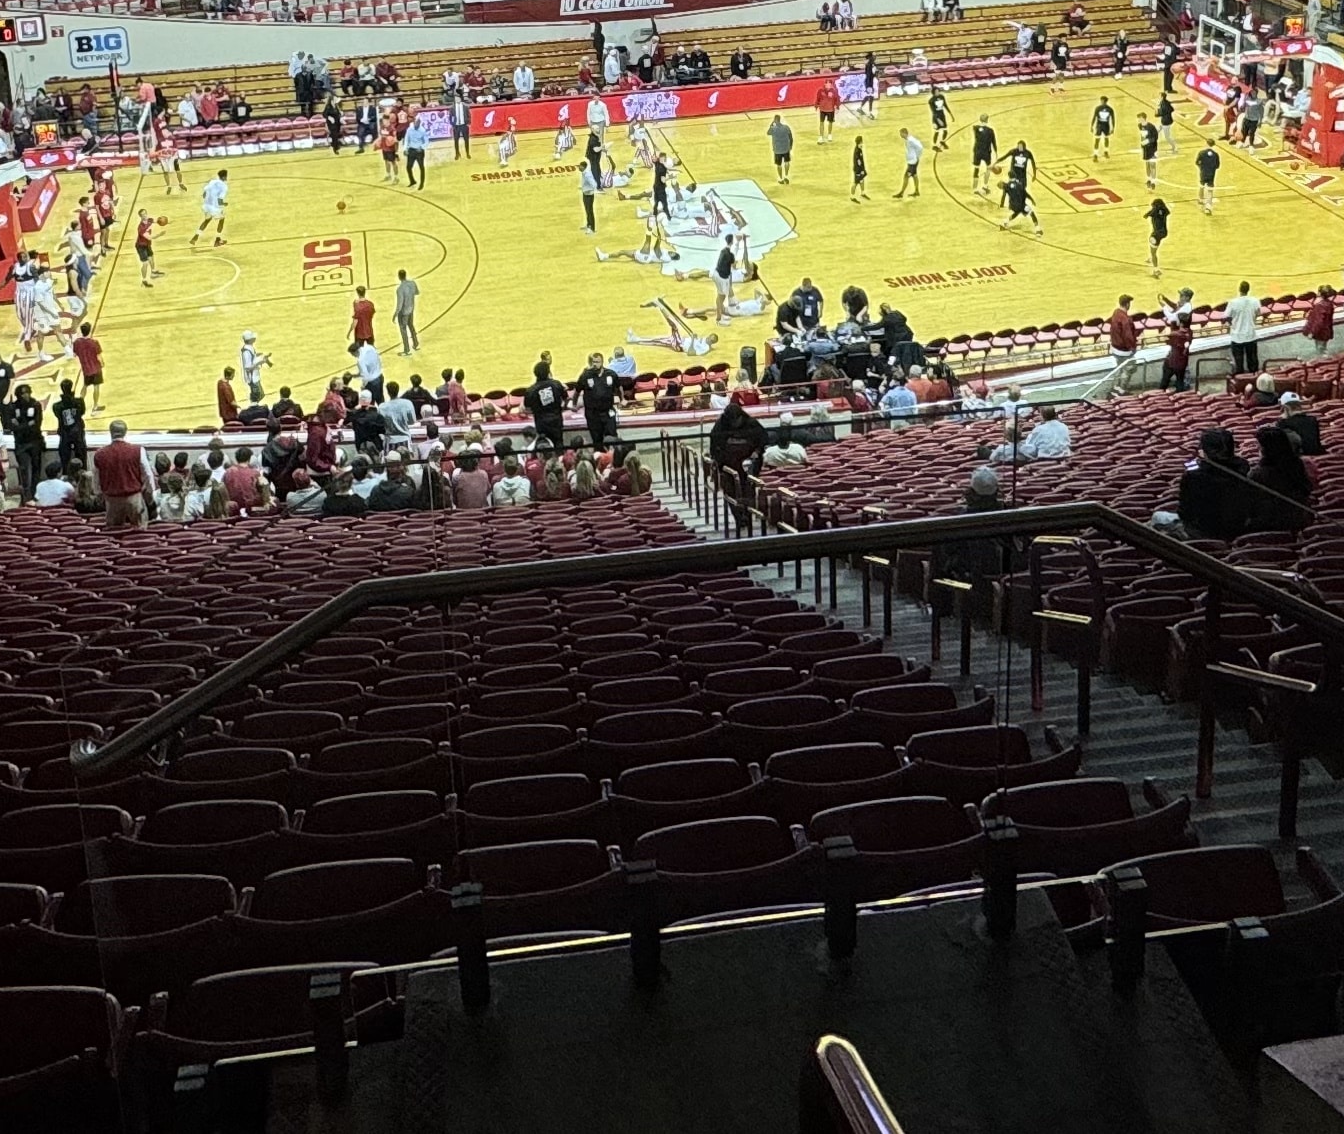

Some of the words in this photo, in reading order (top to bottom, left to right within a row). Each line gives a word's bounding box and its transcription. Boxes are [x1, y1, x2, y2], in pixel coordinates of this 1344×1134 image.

[470, 170, 522, 182] SIMON
[883, 272, 947, 288] SIMON
[945, 264, 1017, 280] SKJODT
